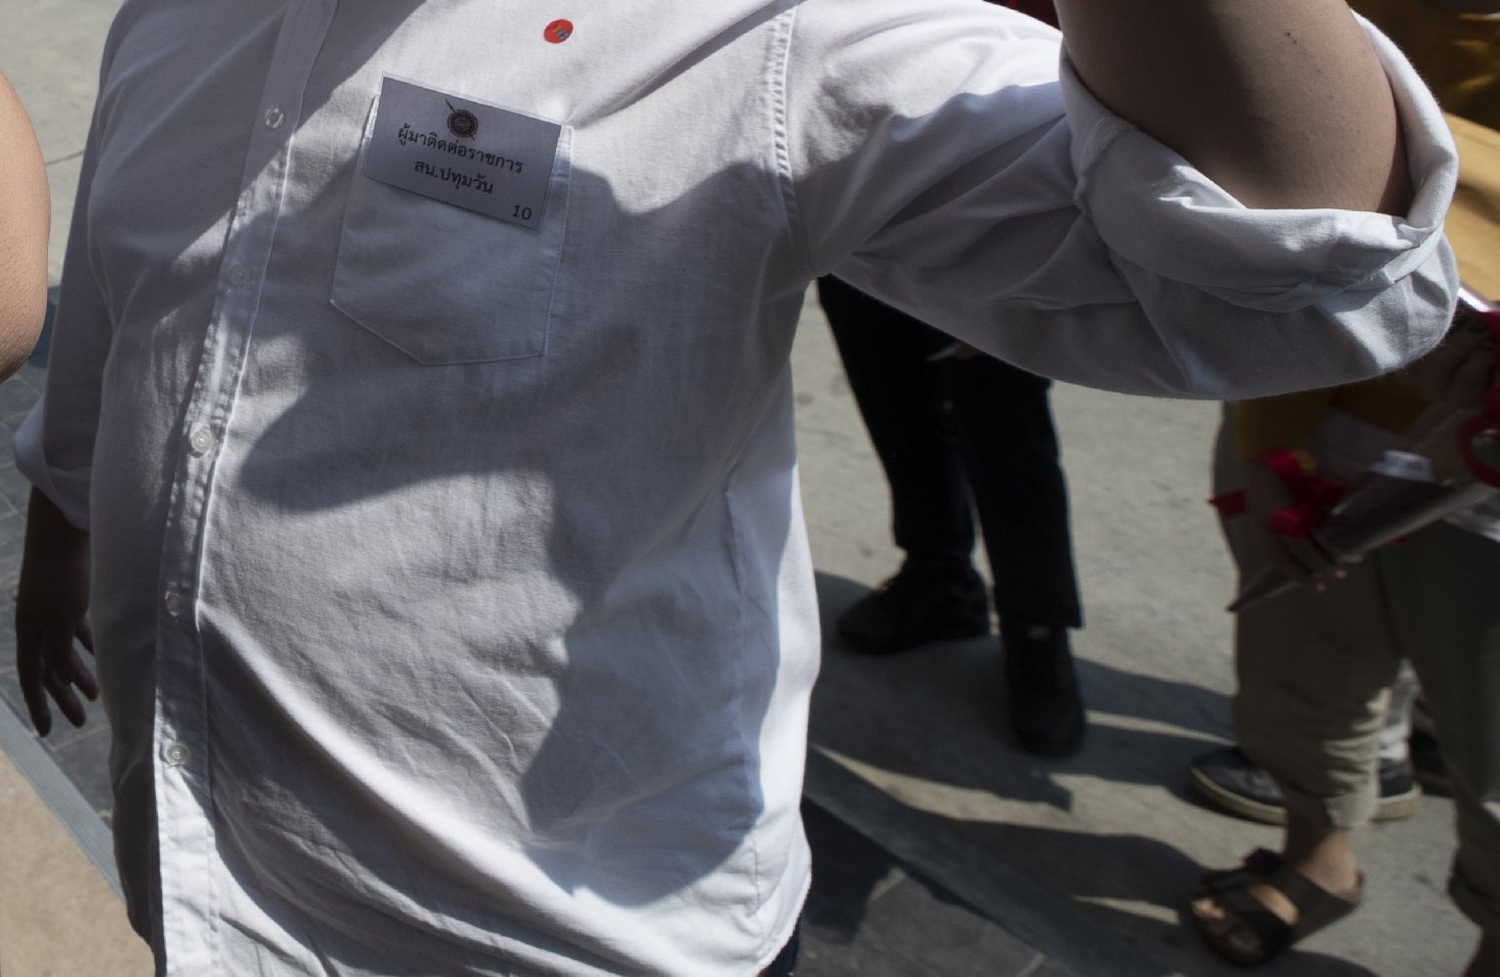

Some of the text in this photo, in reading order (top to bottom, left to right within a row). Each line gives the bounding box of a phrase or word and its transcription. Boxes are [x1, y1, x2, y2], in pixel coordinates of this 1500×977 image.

[398, 123, 524, 174] ผู้มาติดต่อราชการ
[414, 161, 494, 194] สน.ปทุมวัน
[512, 204, 532, 221] 10
